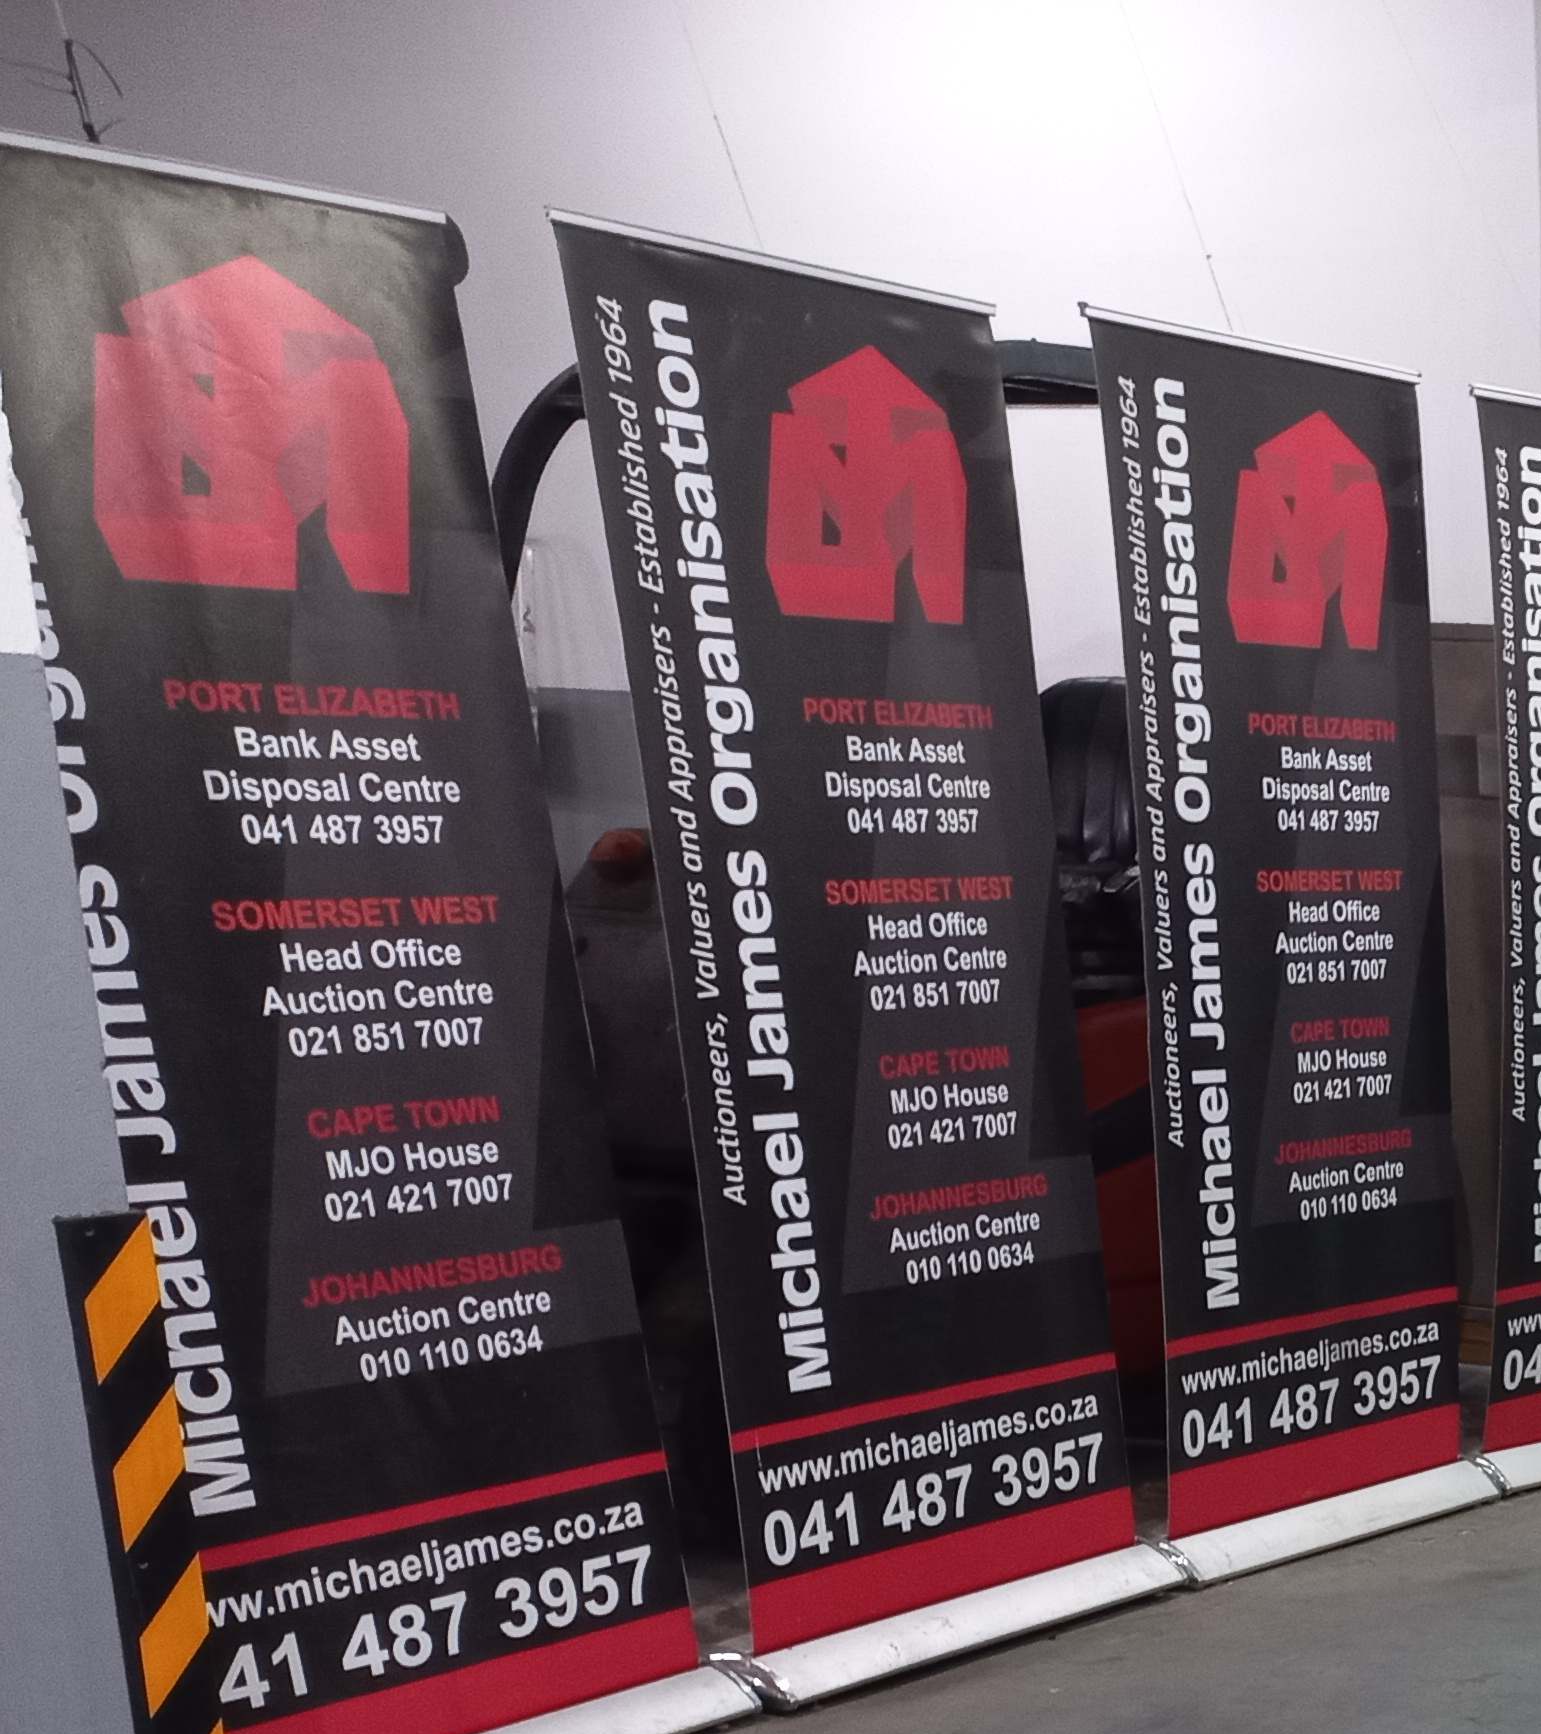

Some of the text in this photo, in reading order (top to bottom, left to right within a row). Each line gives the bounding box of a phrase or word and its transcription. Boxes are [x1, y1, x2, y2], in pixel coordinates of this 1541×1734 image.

[165, 679, 460, 719] PORT ELIZABETH
[803, 696, 993, 728] PORT ELIZABETH
[234, 726, 421, 761] Bank Asset
[596, 295, 747, 1205] Auctioneers, Valuers and Appraisers Established 1964
[846, 735, 966, 764] Bank Asset
[1118, 376, 1184, 1148] Auctioneers, Valuers and Appraisers Established 1964
[1281, 746, 1372, 772] Bank Asset
[203, 770, 460, 808] Disposal Centre
[825, 771, 990, 803] Disposal Centre
[1262, 777, 1390, 805] Disposal Centre
[241, 814, 443, 844] 041 487 3957
[847, 808, 978, 833] 041 487 3957
[1278, 809, 1379, 832] 041 487 3957
[649, 299, 832, 1392] Michael James Organisation
[1153, 377, 1239, 1309] Michael James Organisation
[826, 875, 1012, 905] SOMERSET WEST
[213, 895, 496, 931] SOMERSET WEST
[868, 911, 987, 940] Head Office
[1289, 900, 1380, 923] Head Office
[280, 938, 461, 972] Head Office
[1275, 930, 1393, 954] Auction Centre
[855, 946, 1007, 976] Auction Centre
[1287, 958, 1387, 984] 021 851 7007
[80, 864, 176, 1155] James
[263, 979, 493, 1016] Auction Centre
[870, 978, 1000, 1011] 021 851 7007
[289, 1017, 483, 1057] 021 851 7007
[879, 1046, 1010, 1079] CAPE TOWN
[1298, 1049, 1387, 1073] MJO House
[890, 1083, 1008, 1114] MJO House
[1294, 1074, 1392, 1104] 021 421 7007
[307, 1097, 501, 1139] CAPE TOWN
[888, 1111, 1017, 1149] 021 421 7007
[325, 1142, 499, 1180] MJO House
[1289, 1161, 1404, 1193] Auction Centre
[325, 1173, 512, 1222] 021 421 7007
[872, 1173, 1048, 1221] JOHANNESBURG
[1300, 1187, 1397, 1220] 010 110 0634
[890, 1211, 1040, 1253] Auction Centre
[304, 1243, 563, 1307] JOHANNESBURG
[906, 1241, 1034, 1284] 010 110 0634
[336, 1290, 551, 1345] Auction Centre
[360, 1325, 543, 1382] 010 110 0634
[1181, 1322, 1439, 1395] www.michaeljames.co.za
[1183, 1355, 1441, 1457] 041 487 3957
[758, 1394, 1098, 1494] www.michaeljames.co.za
[764, 1432, 1103, 1566] 041 487 3957
[207, 1501, 644, 1628] ww.michaeljames.co.za
[219, 1544, 651, 1708] 41 487 3957
